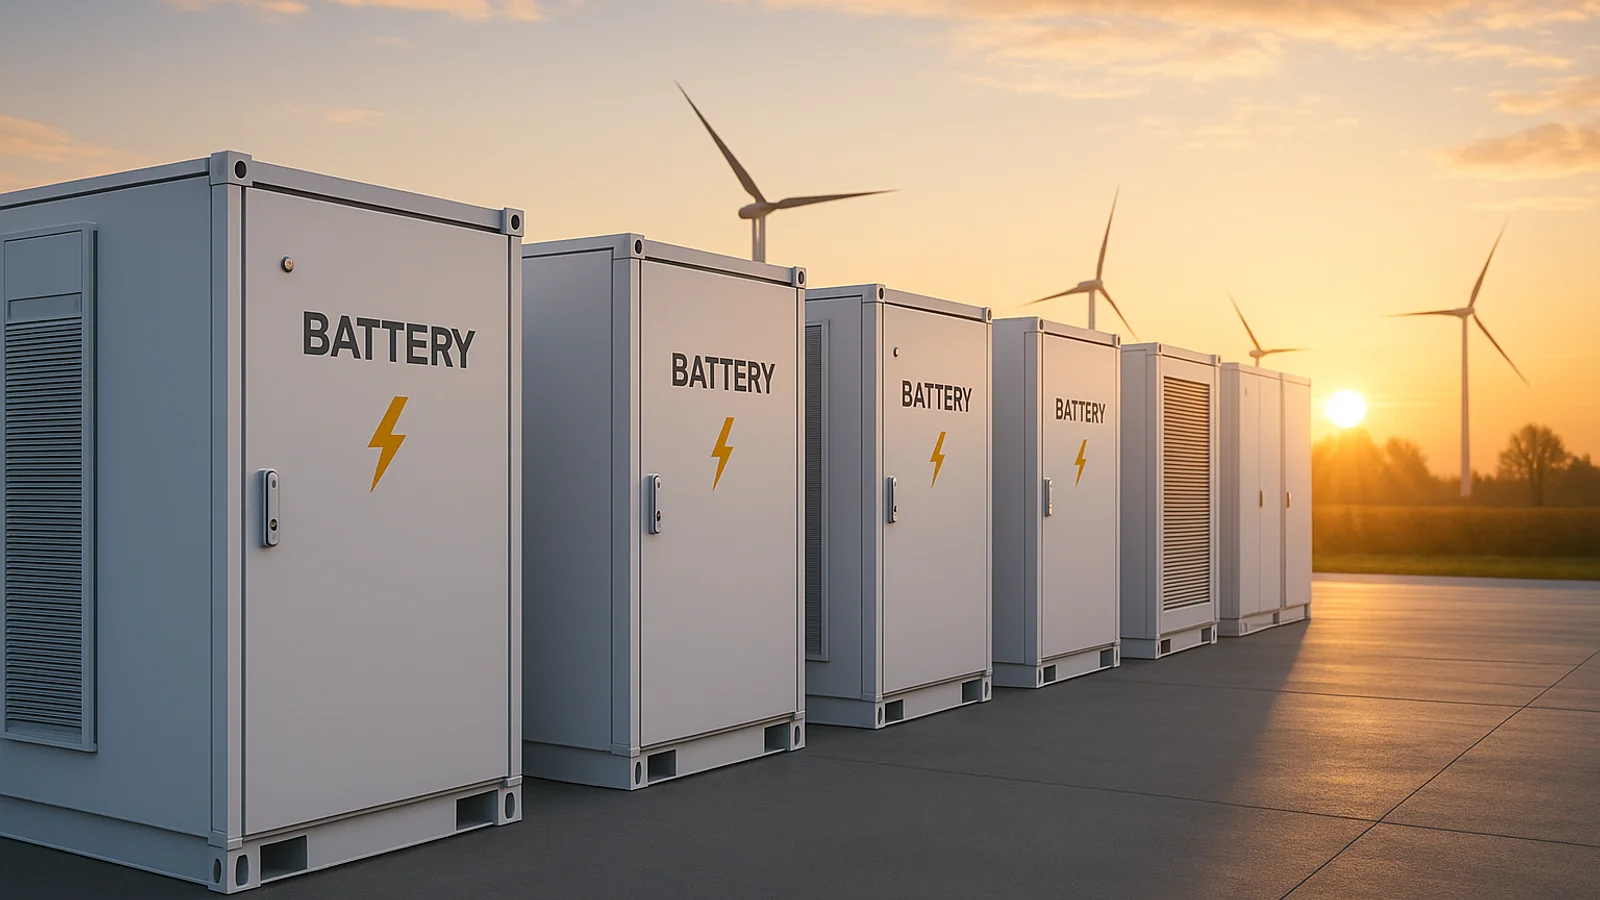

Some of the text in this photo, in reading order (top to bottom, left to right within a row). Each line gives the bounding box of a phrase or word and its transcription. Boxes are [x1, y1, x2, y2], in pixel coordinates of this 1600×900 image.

[303, 311, 476, 369] BATTERY
[672, 352, 776, 394] BATTERY
[901, 380, 972, 413] BATTERY
[1055, 397, 1106, 424] BATTERY
